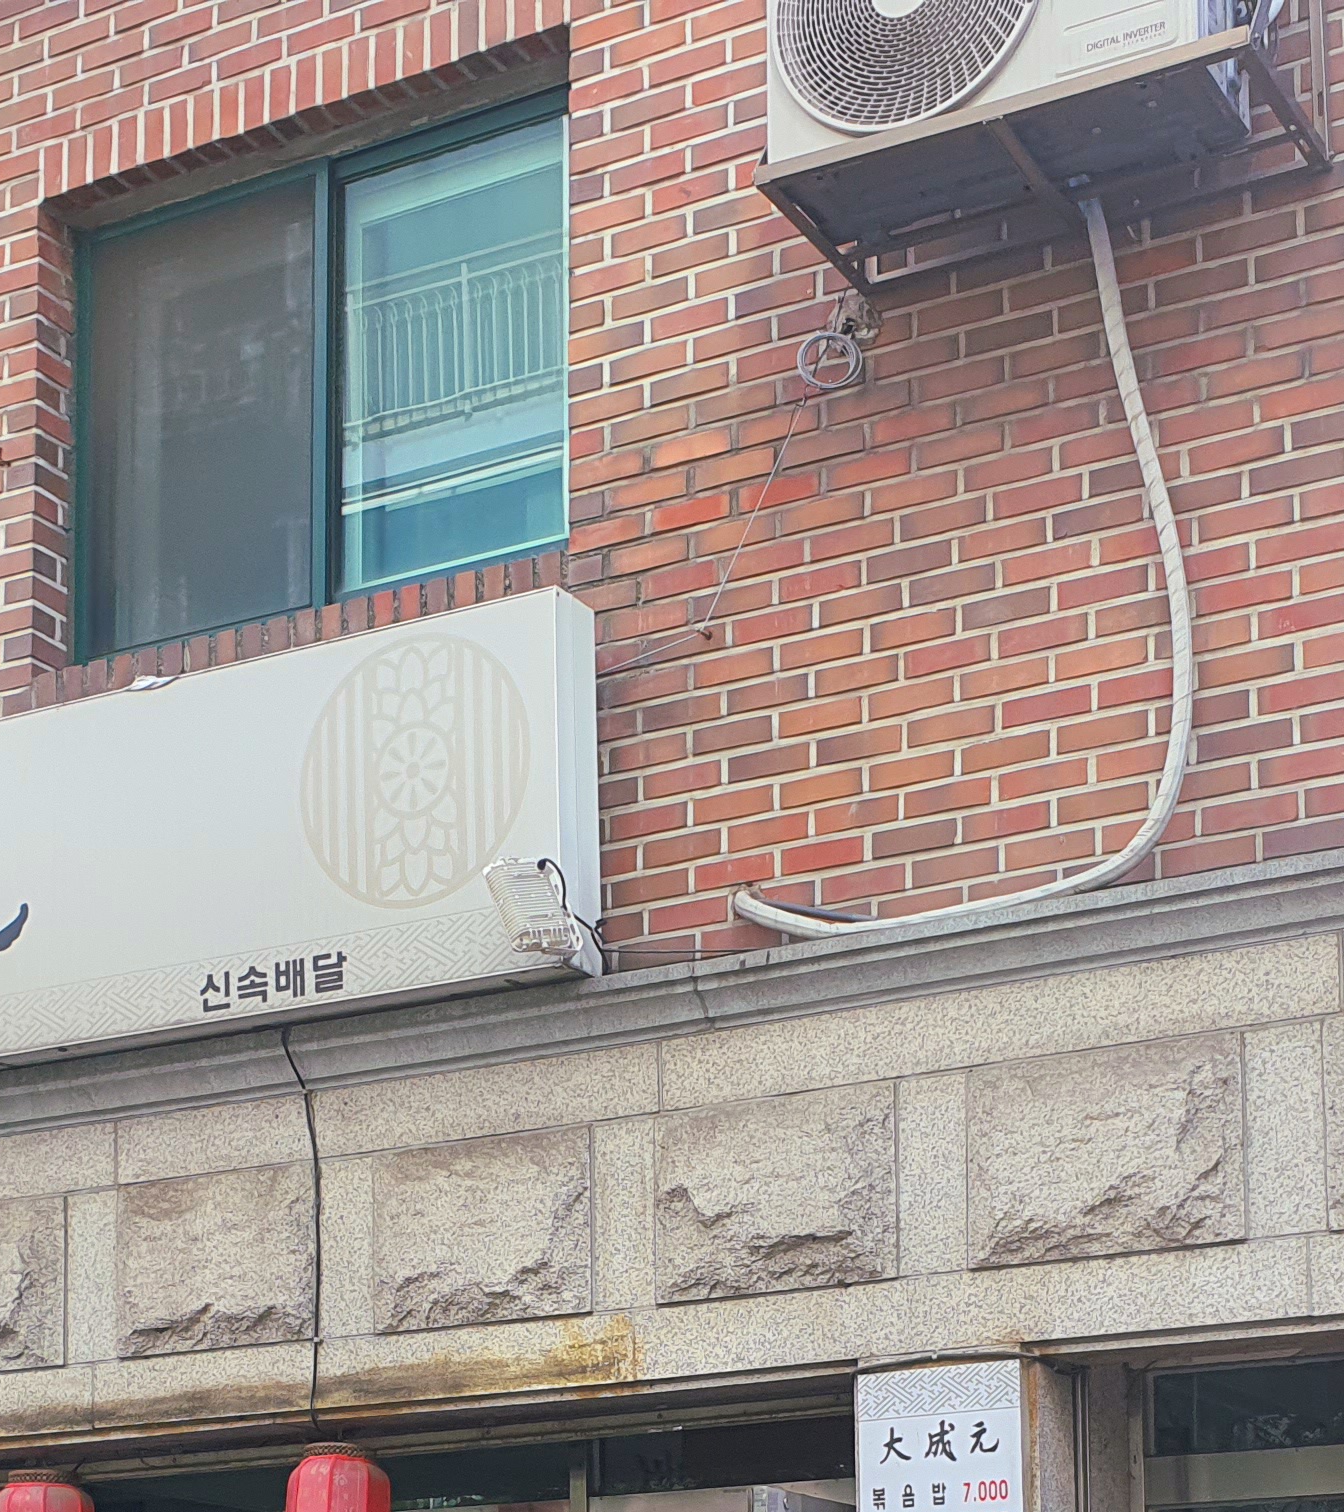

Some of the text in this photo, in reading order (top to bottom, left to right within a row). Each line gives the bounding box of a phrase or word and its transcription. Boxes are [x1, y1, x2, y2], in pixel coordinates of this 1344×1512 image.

[1086, 35, 1121, 52] DIGITAL
[1122, 21, 1166, 41] INVERTER
[199, 951, 349, 1014] 신속배달
[872, 1479, 1009, 1510] 볶음밥 7.000
